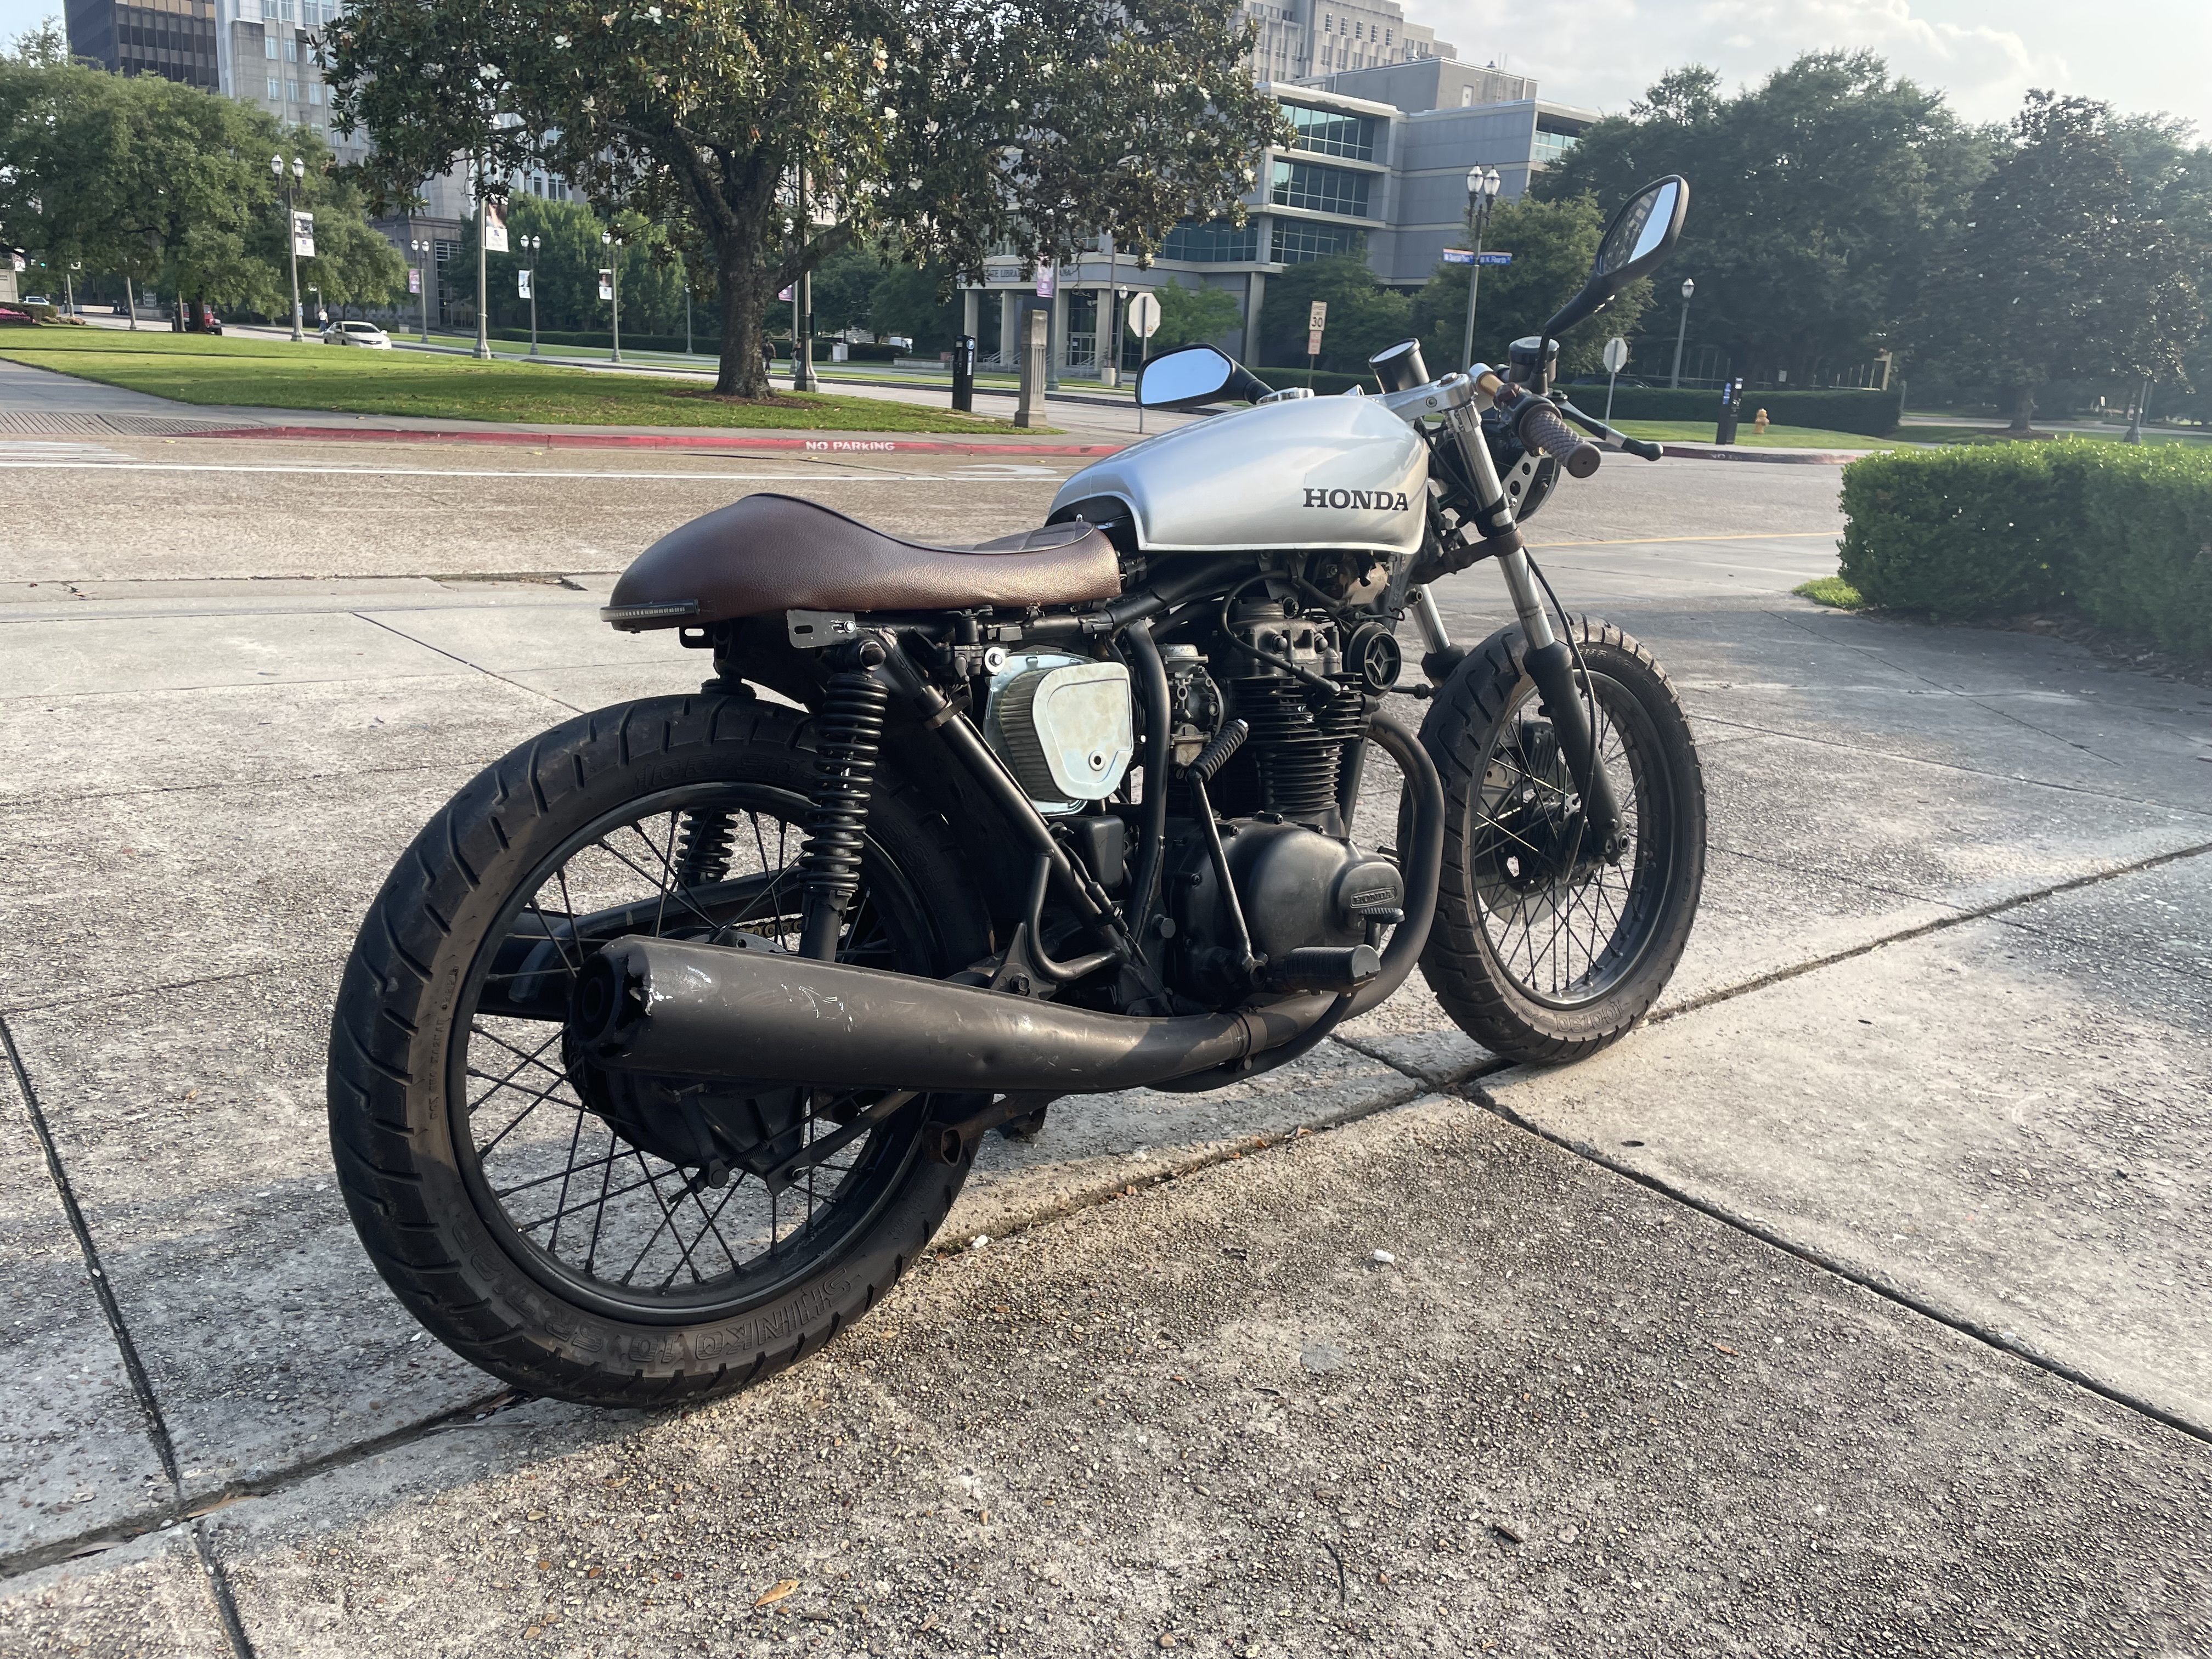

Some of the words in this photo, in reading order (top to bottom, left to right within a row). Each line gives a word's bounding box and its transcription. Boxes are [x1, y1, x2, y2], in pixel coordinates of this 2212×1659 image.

[1311, 317, 1323, 327] 30
[805, 441, 828, 450] NO
[833, 441, 896, 451] PARKING
[1303, 488, 1409, 511] HONDA
[1353, 889, 1394, 905] HONDA
[695, 1268, 853, 1361] SHINKO
